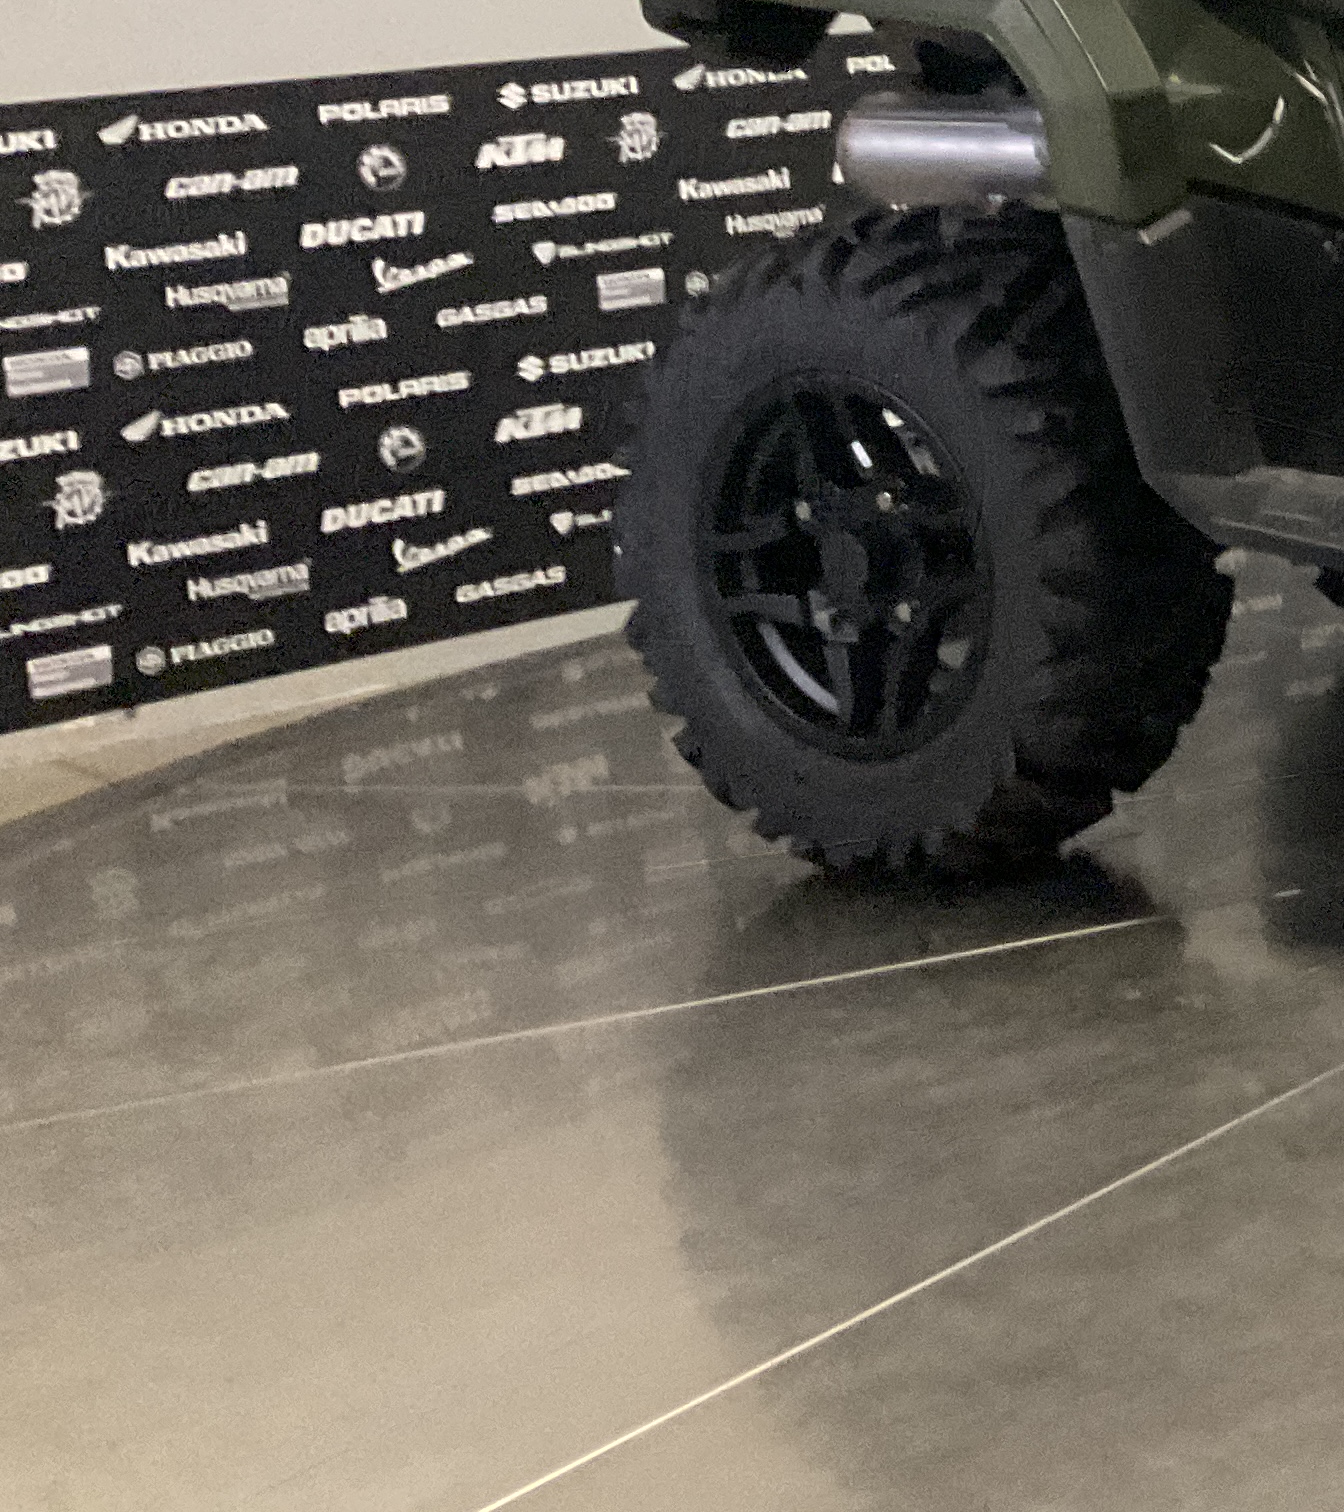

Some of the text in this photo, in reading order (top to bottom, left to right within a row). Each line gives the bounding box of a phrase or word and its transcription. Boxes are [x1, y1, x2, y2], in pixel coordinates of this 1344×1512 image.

[531, 76, 639, 103] SUZUKI
[318, 95, 450, 124] POLARIS
[0, 129, 57, 154] UKI
[138, 114, 268, 141] HONDA
[476, 133, 564, 168] KTM
[300, 211, 425, 248] DUCATI
[105, 231, 246, 270] Kawasaki
[436, 295, 547, 327] GASGAS
[549, 341, 655, 373] SUZUKI
[339, 372, 471, 408] POLARIS
[160, 403, 289, 436] HONDA
[495, 403, 582, 443] KTM
[321, 489, 445, 533] DUCATI
